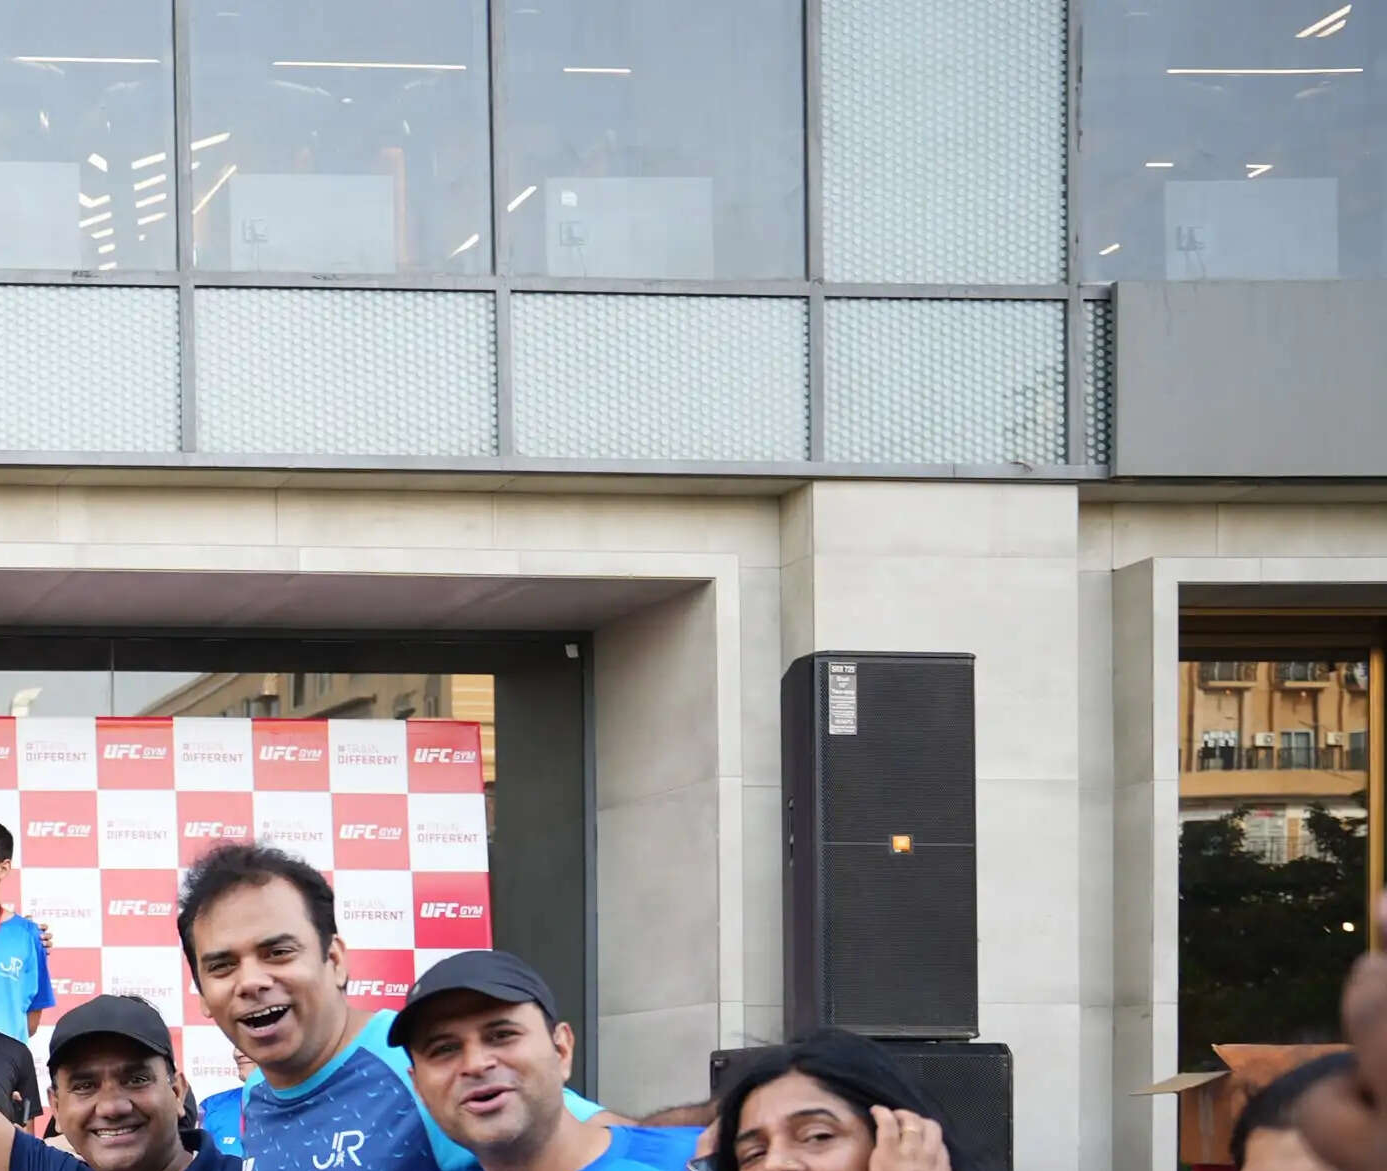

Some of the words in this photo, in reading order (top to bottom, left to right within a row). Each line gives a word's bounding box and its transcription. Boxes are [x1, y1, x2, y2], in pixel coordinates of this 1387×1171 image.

[26, 752, 87, 762] DIFFERENT
[103, 744, 141, 759] UFC
[182, 752, 244, 763] DIFFERENT
[259, 746, 298, 761] UFC
[413, 748, 452, 763] UFC
[338, 754, 399, 765] DIFFERENT
[27, 821, 66, 837] UFC
[107, 830, 168, 840] DIFFERENT
[184, 822, 223, 837] UFC
[339, 824, 378, 839] UFC
[417, 833, 478, 843] DIFFERENT
[108, 900, 147, 915] UFC
[420, 903, 459, 918] UFC
[344, 911, 405, 921] DIFFERENT
[346, 981, 384, 996] UFC
[192, 1067, 239, 1077] DIFFERE
[312, 1130, 365, 1170] JR
